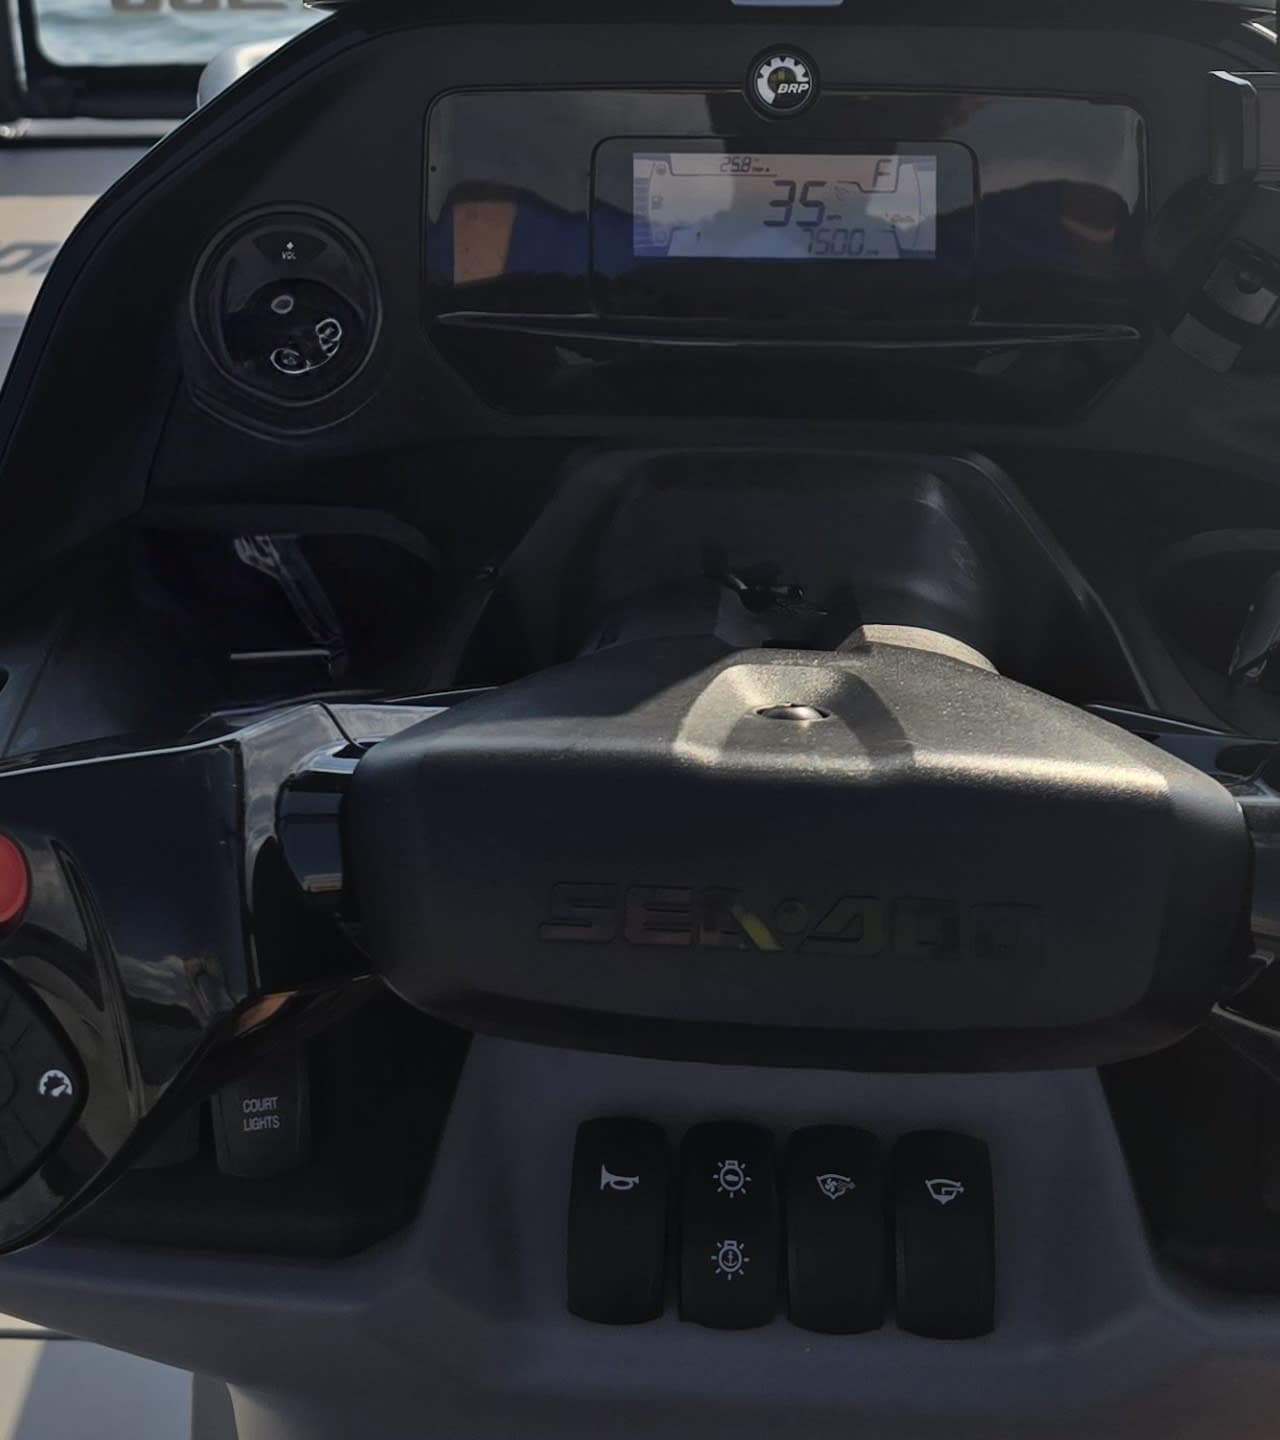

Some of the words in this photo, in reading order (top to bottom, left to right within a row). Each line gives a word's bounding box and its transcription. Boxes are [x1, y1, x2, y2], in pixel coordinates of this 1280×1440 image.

[777, 83, 809, 94] BRP
[763, 180, 828, 227] 35
[242, 1096, 278, 1113] COURT
[243, 1115, 280, 1131] LIGHTS
